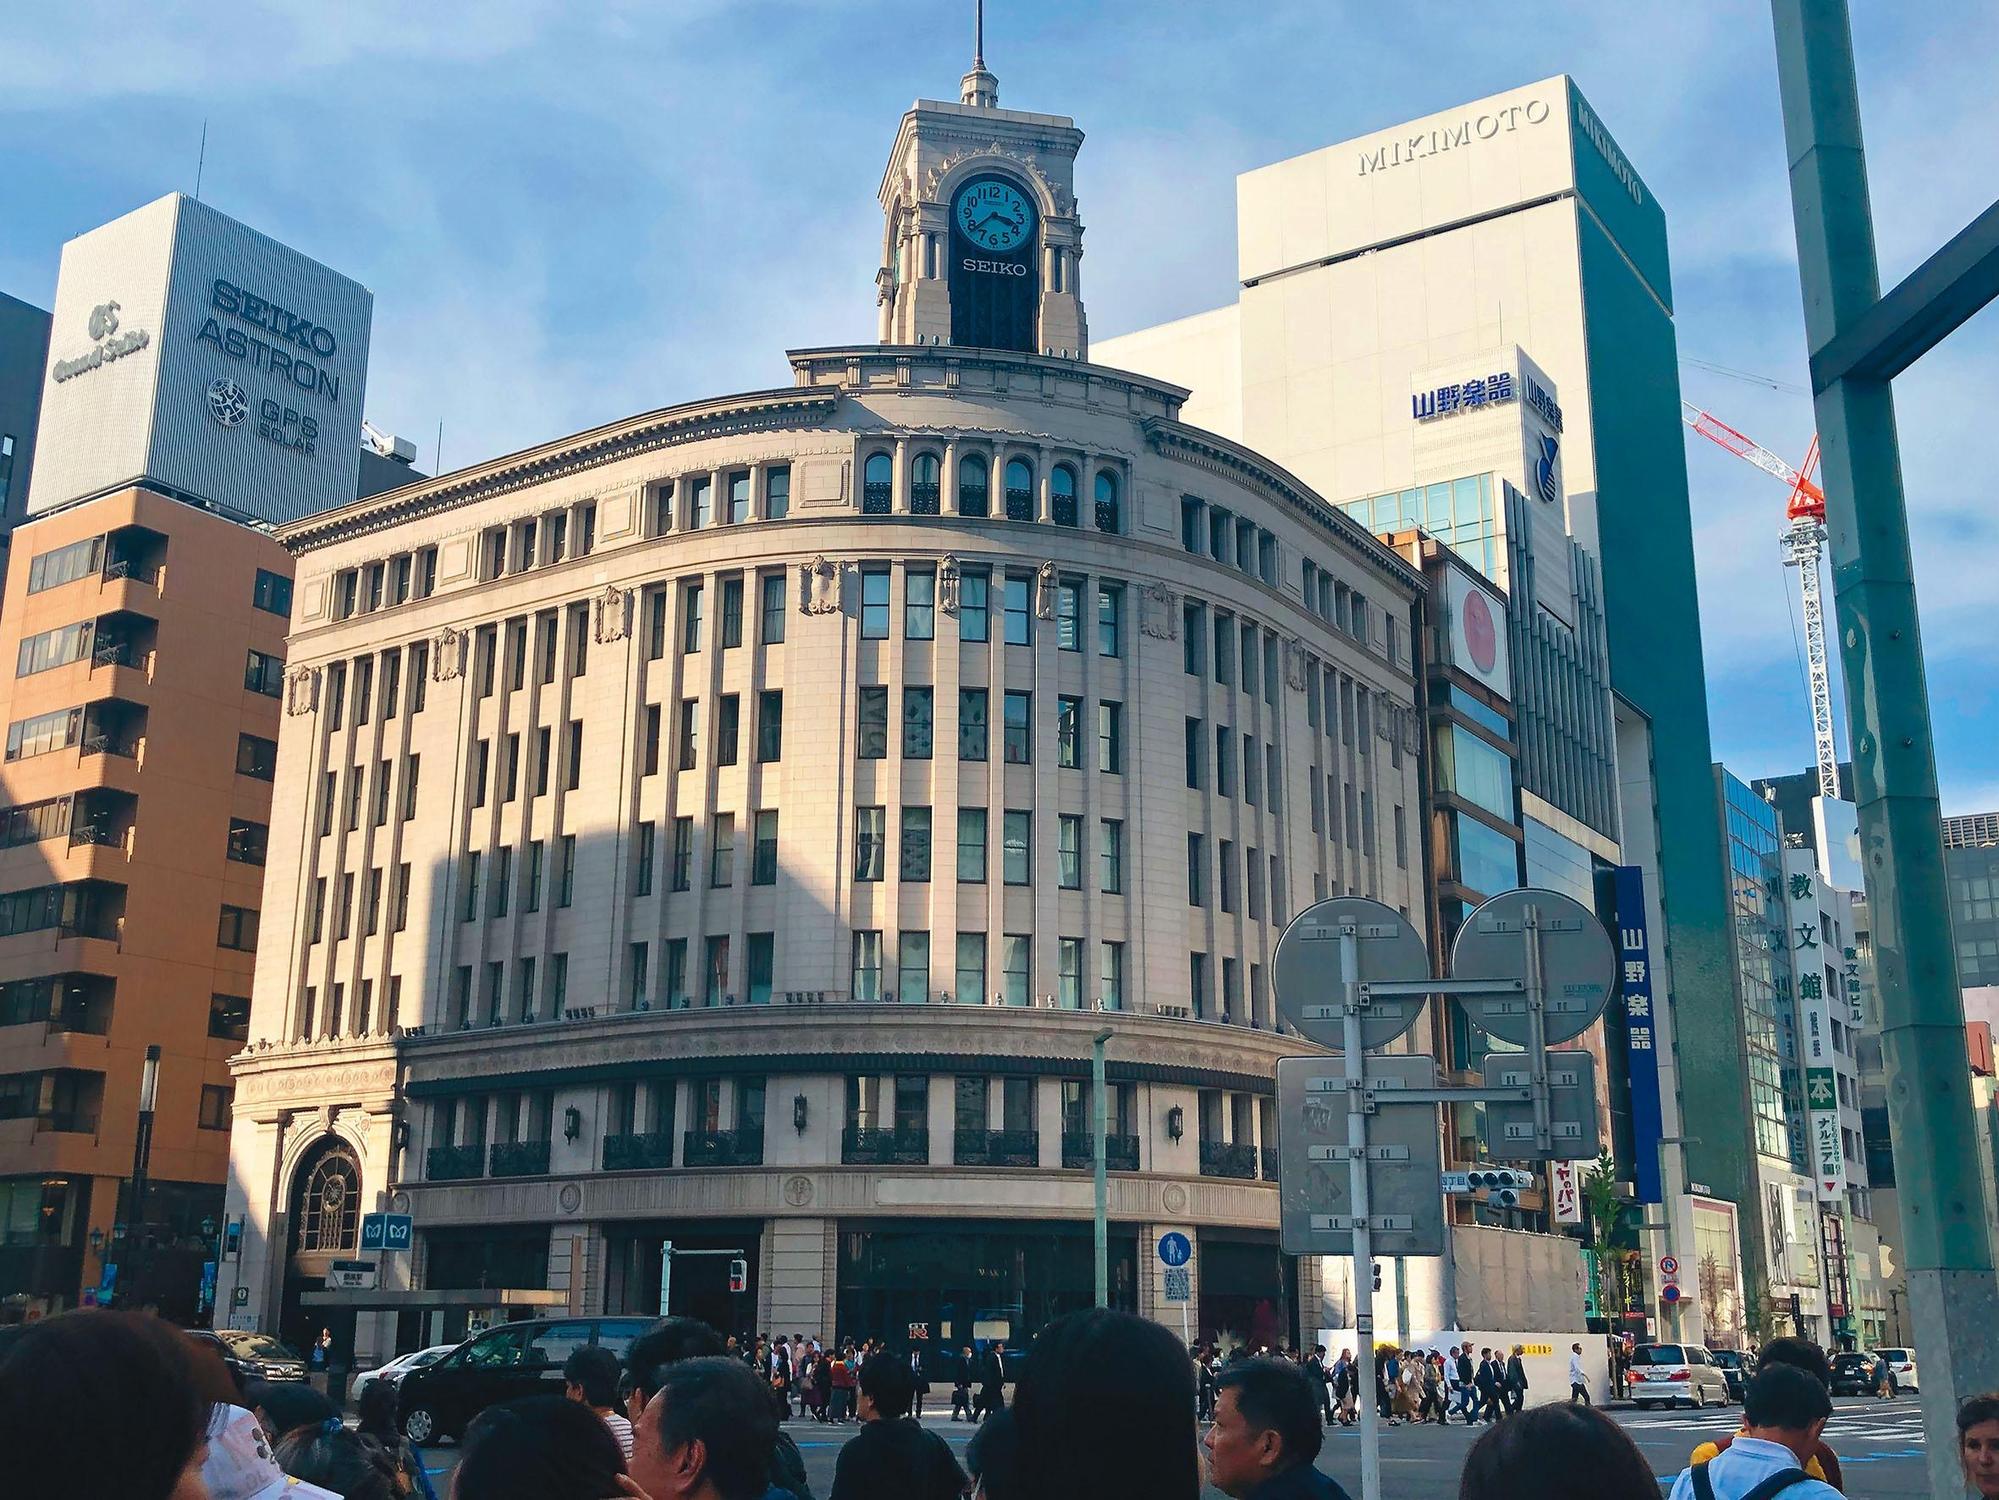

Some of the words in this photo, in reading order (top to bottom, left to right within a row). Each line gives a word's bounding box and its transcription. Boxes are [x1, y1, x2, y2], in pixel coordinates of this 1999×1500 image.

[1357, 100, 1550, 176] MIKIMOTO
[1577, 101, 1641, 205] MIKIMOTO
[967, 196, 978, 208] 10
[978, 188, 986, 199] 11
[989, 187, 1000, 198] 12
[1012, 200, 1021, 212] 2
[963, 207, 972, 219] 9
[978, 229, 987, 240] 7
[989, 234, 998, 245] 6
[1001, 232, 1010, 244] 5
[963, 258, 1027, 276] SEIKO
[212, 278, 337, 358] SEIKO
[195, 317, 340, 402] ASTRON
[1412, 372, 1511, 420] 山野楽器
[260, 398, 319, 439] GPS
[257, 422, 315, 459] SOLAR
[1789, 872, 1822, 1000] 教文館
[1622, 928, 1651, 1049] 山野楽器
[1809, 1074, 1833, 1103] 本
